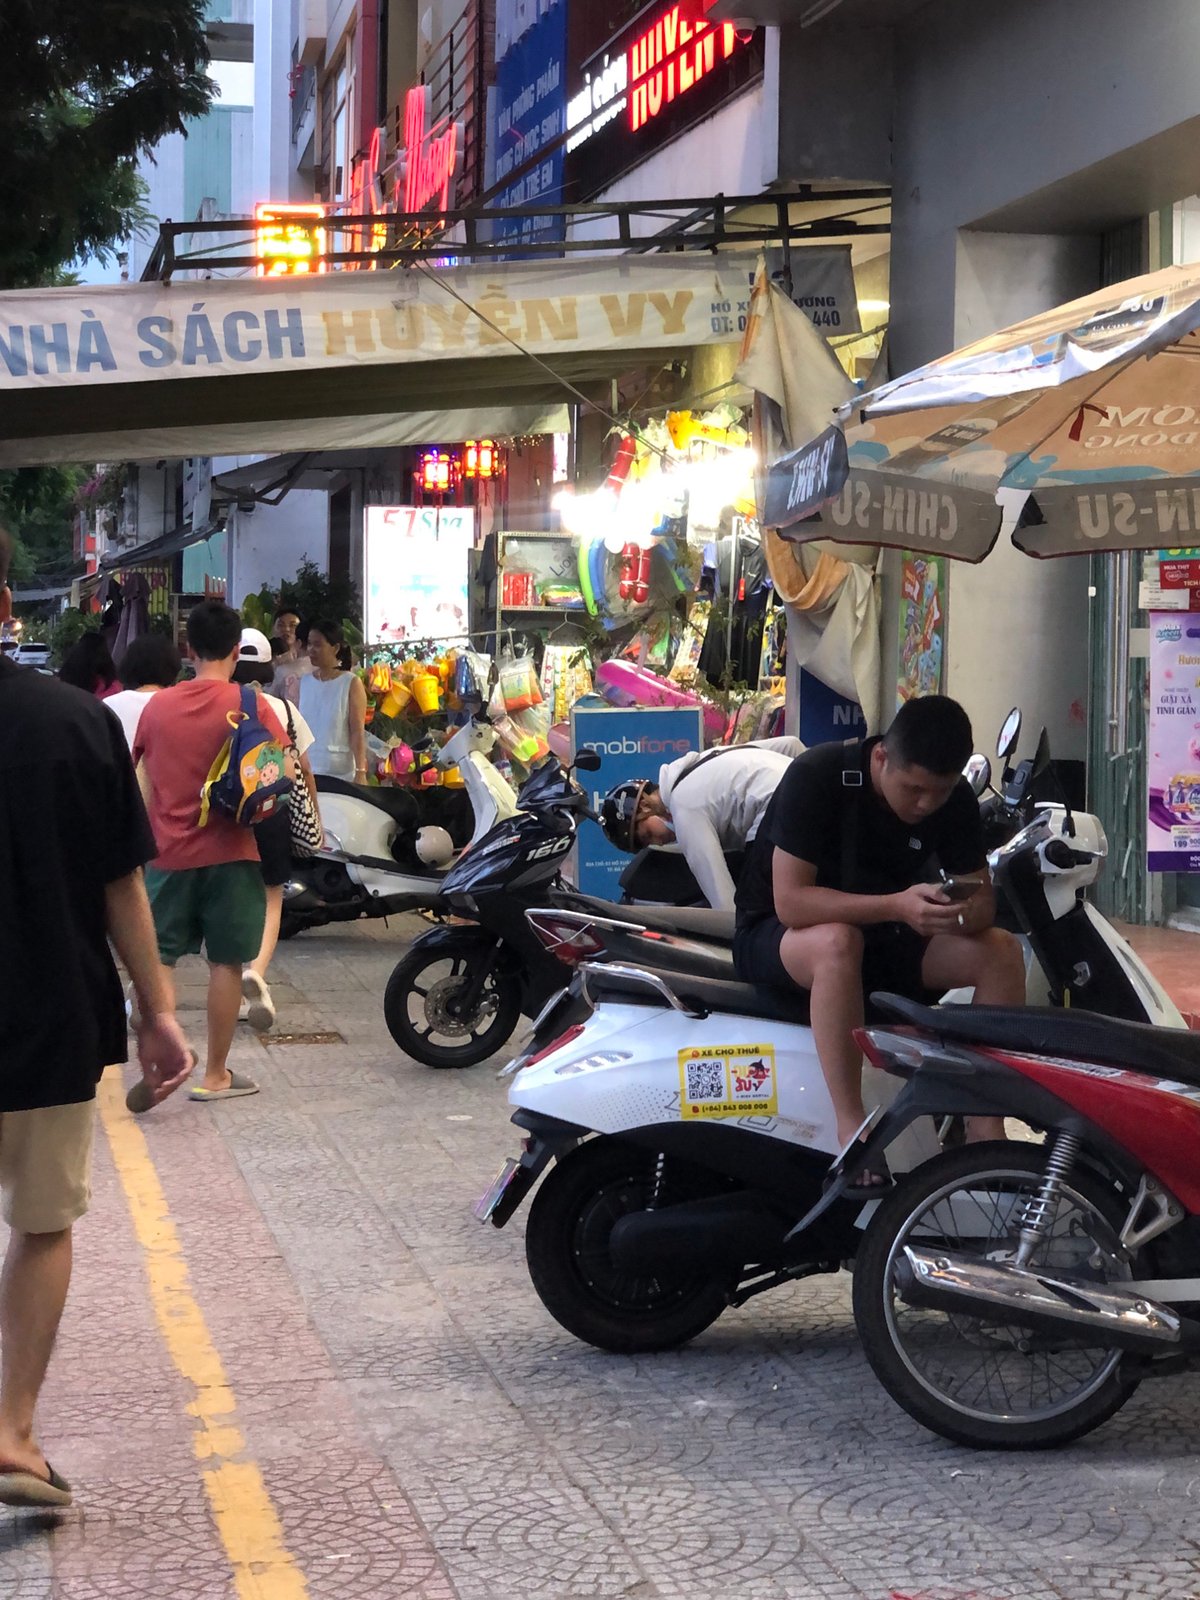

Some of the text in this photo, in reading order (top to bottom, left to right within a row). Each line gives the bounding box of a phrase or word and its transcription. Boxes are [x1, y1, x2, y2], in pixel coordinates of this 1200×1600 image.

[0, 310, 118, 377] NHÀ
[137, 302, 306, 368] SÁCH
[600, 290, 694, 338] VY
[583, 736, 691, 756] mobifone
[701, 1046, 760, 1057] XE CHO THUÊ
